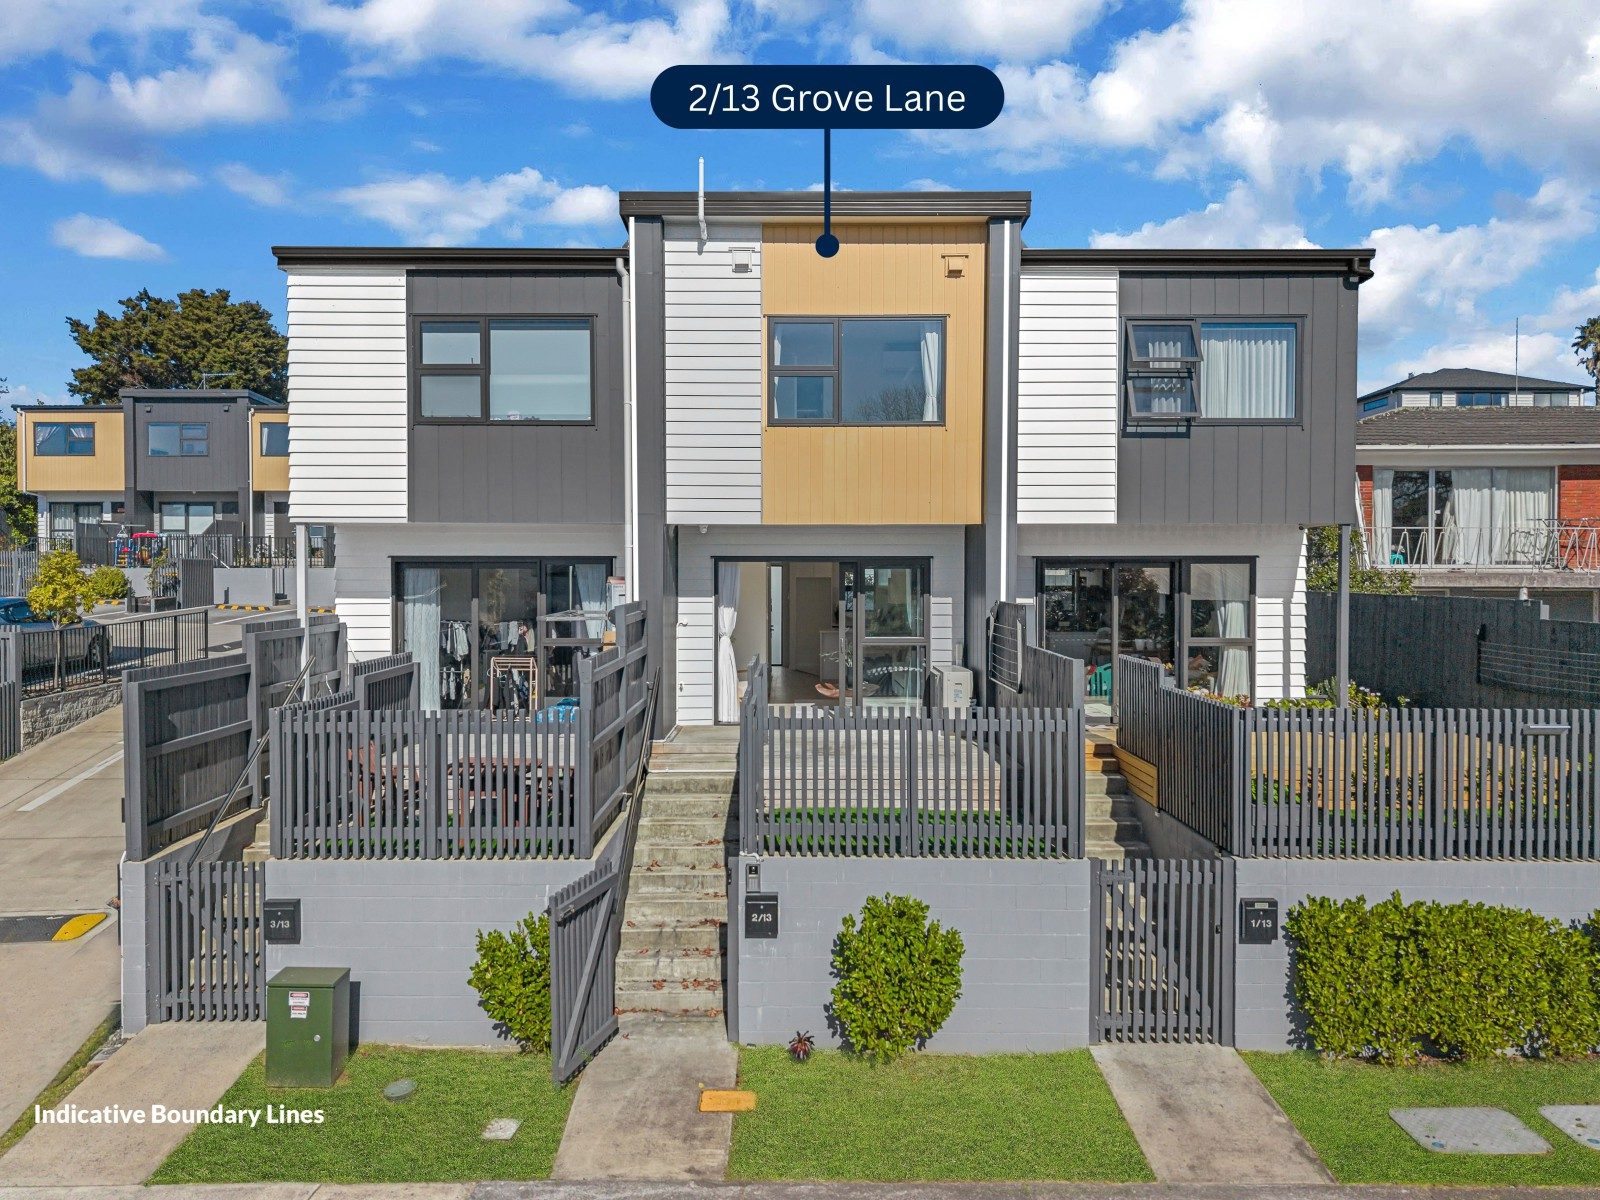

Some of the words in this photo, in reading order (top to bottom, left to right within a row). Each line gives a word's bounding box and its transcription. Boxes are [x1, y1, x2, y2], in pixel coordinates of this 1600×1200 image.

[751, 913, 772, 922] 2/13
[270, 920, 290, 929] 3/13
[1250, 919, 1272, 928] 1/13
